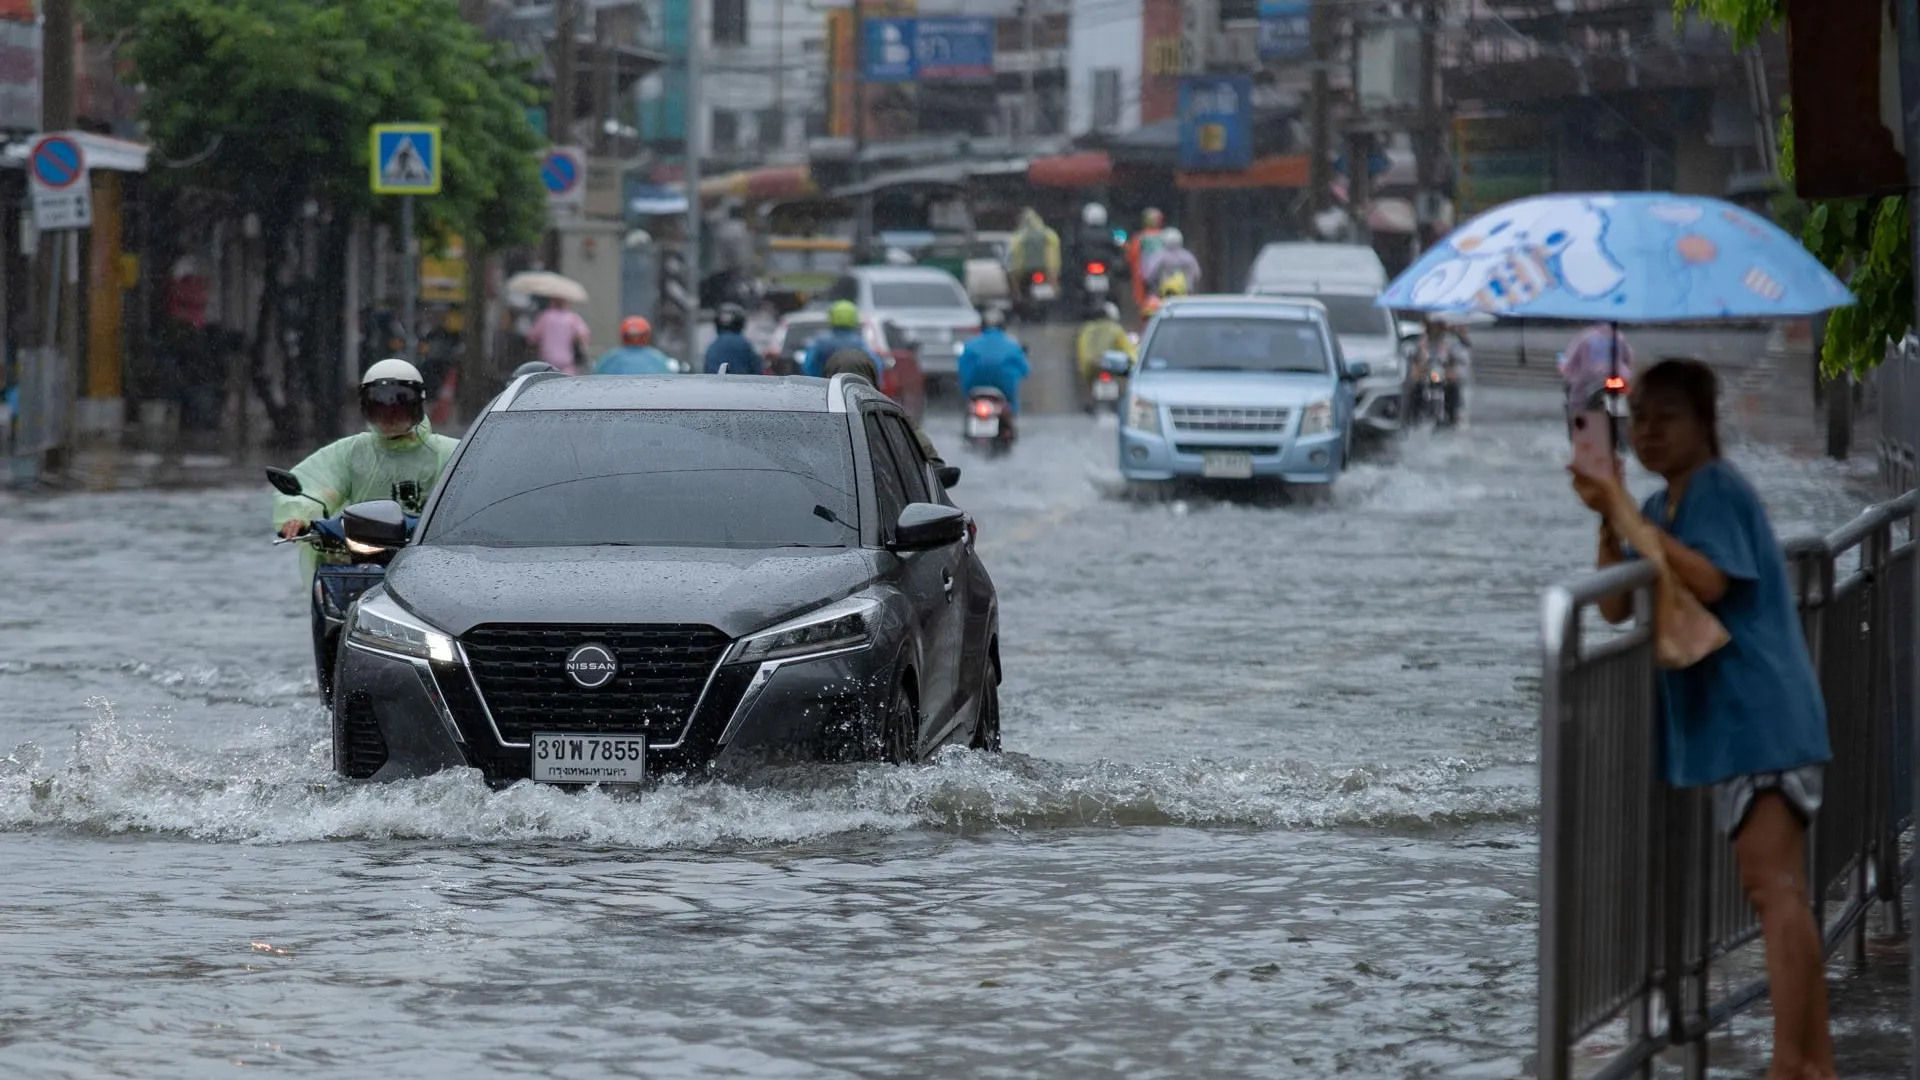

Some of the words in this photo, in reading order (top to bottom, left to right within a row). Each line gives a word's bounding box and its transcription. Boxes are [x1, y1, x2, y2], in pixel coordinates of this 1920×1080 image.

[566, 662, 616, 670] NISSAN
[588, 740, 640, 761] 7855
[548, 766, 628, 778] กรุงเทพมหานคร
